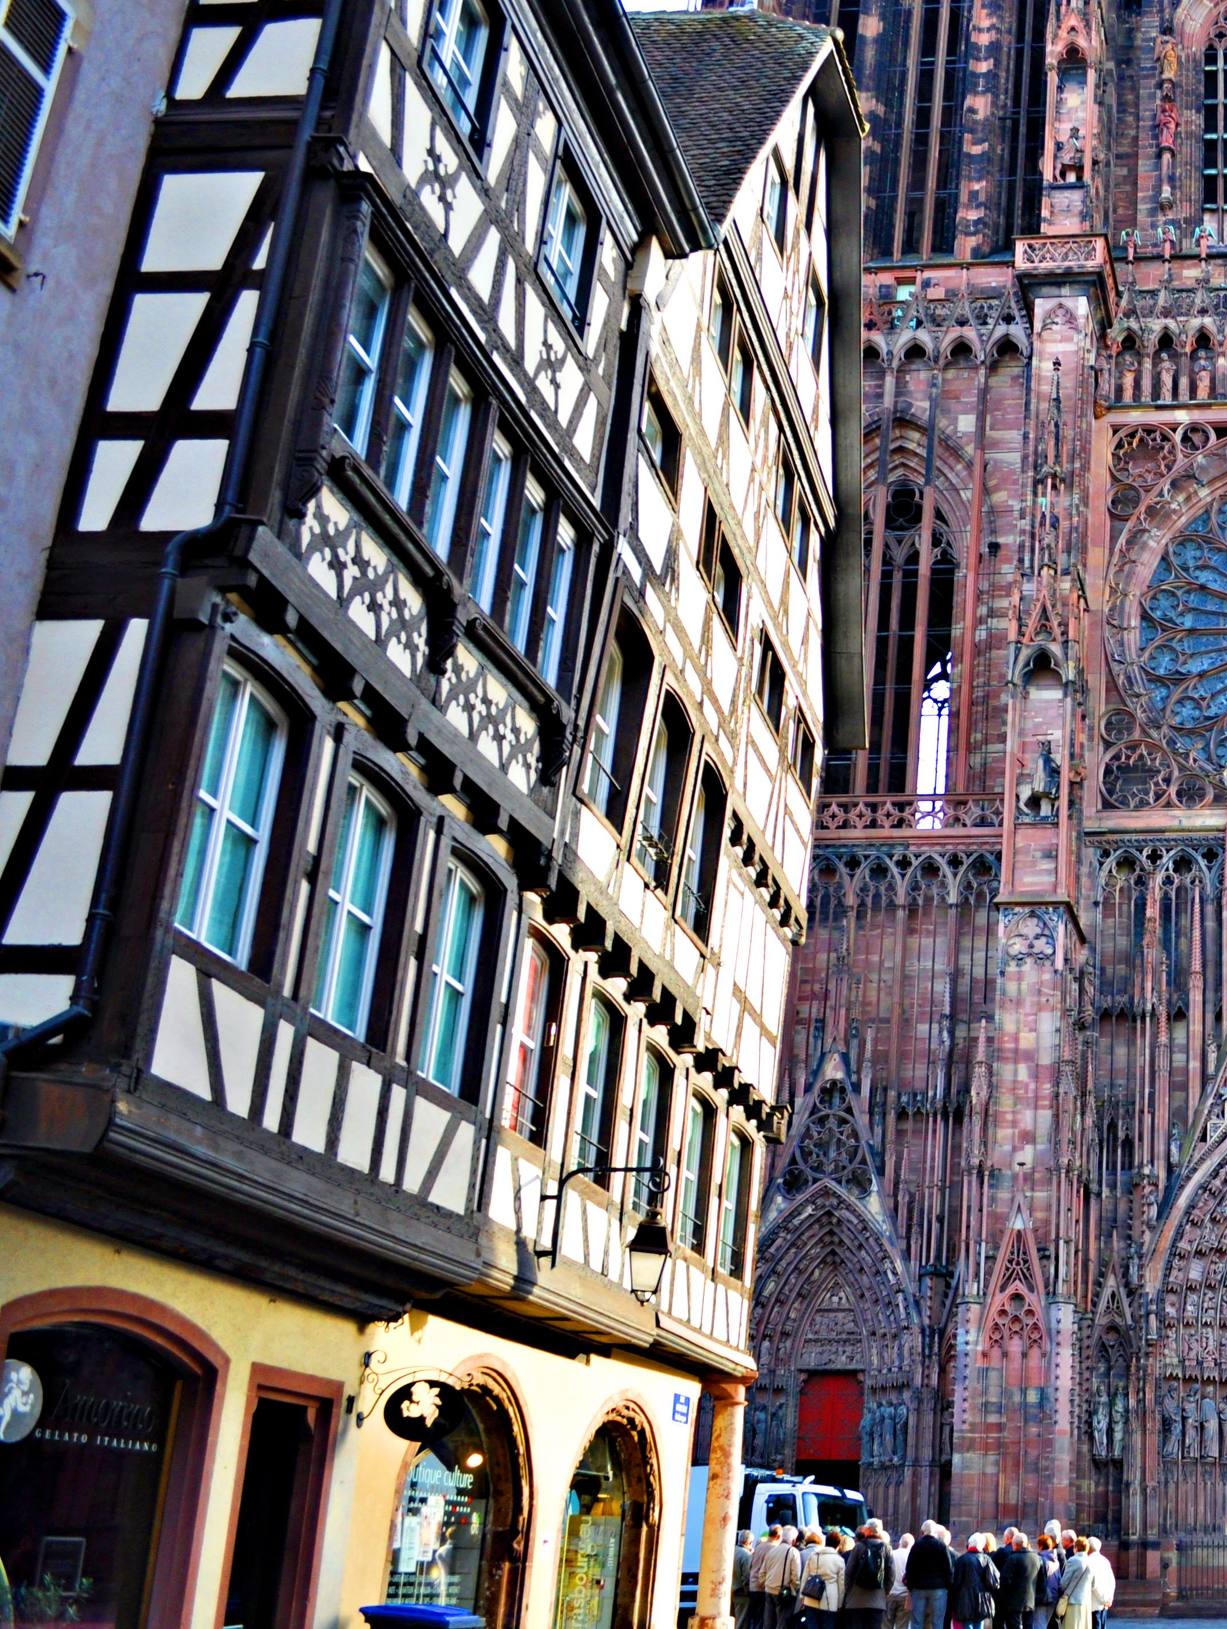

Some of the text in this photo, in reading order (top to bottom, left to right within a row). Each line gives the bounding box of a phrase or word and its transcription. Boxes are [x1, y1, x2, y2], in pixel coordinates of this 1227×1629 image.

[34, 1428, 158, 1453] GELATO ITALIANO
[443, 1464, 474, 1490] culture
